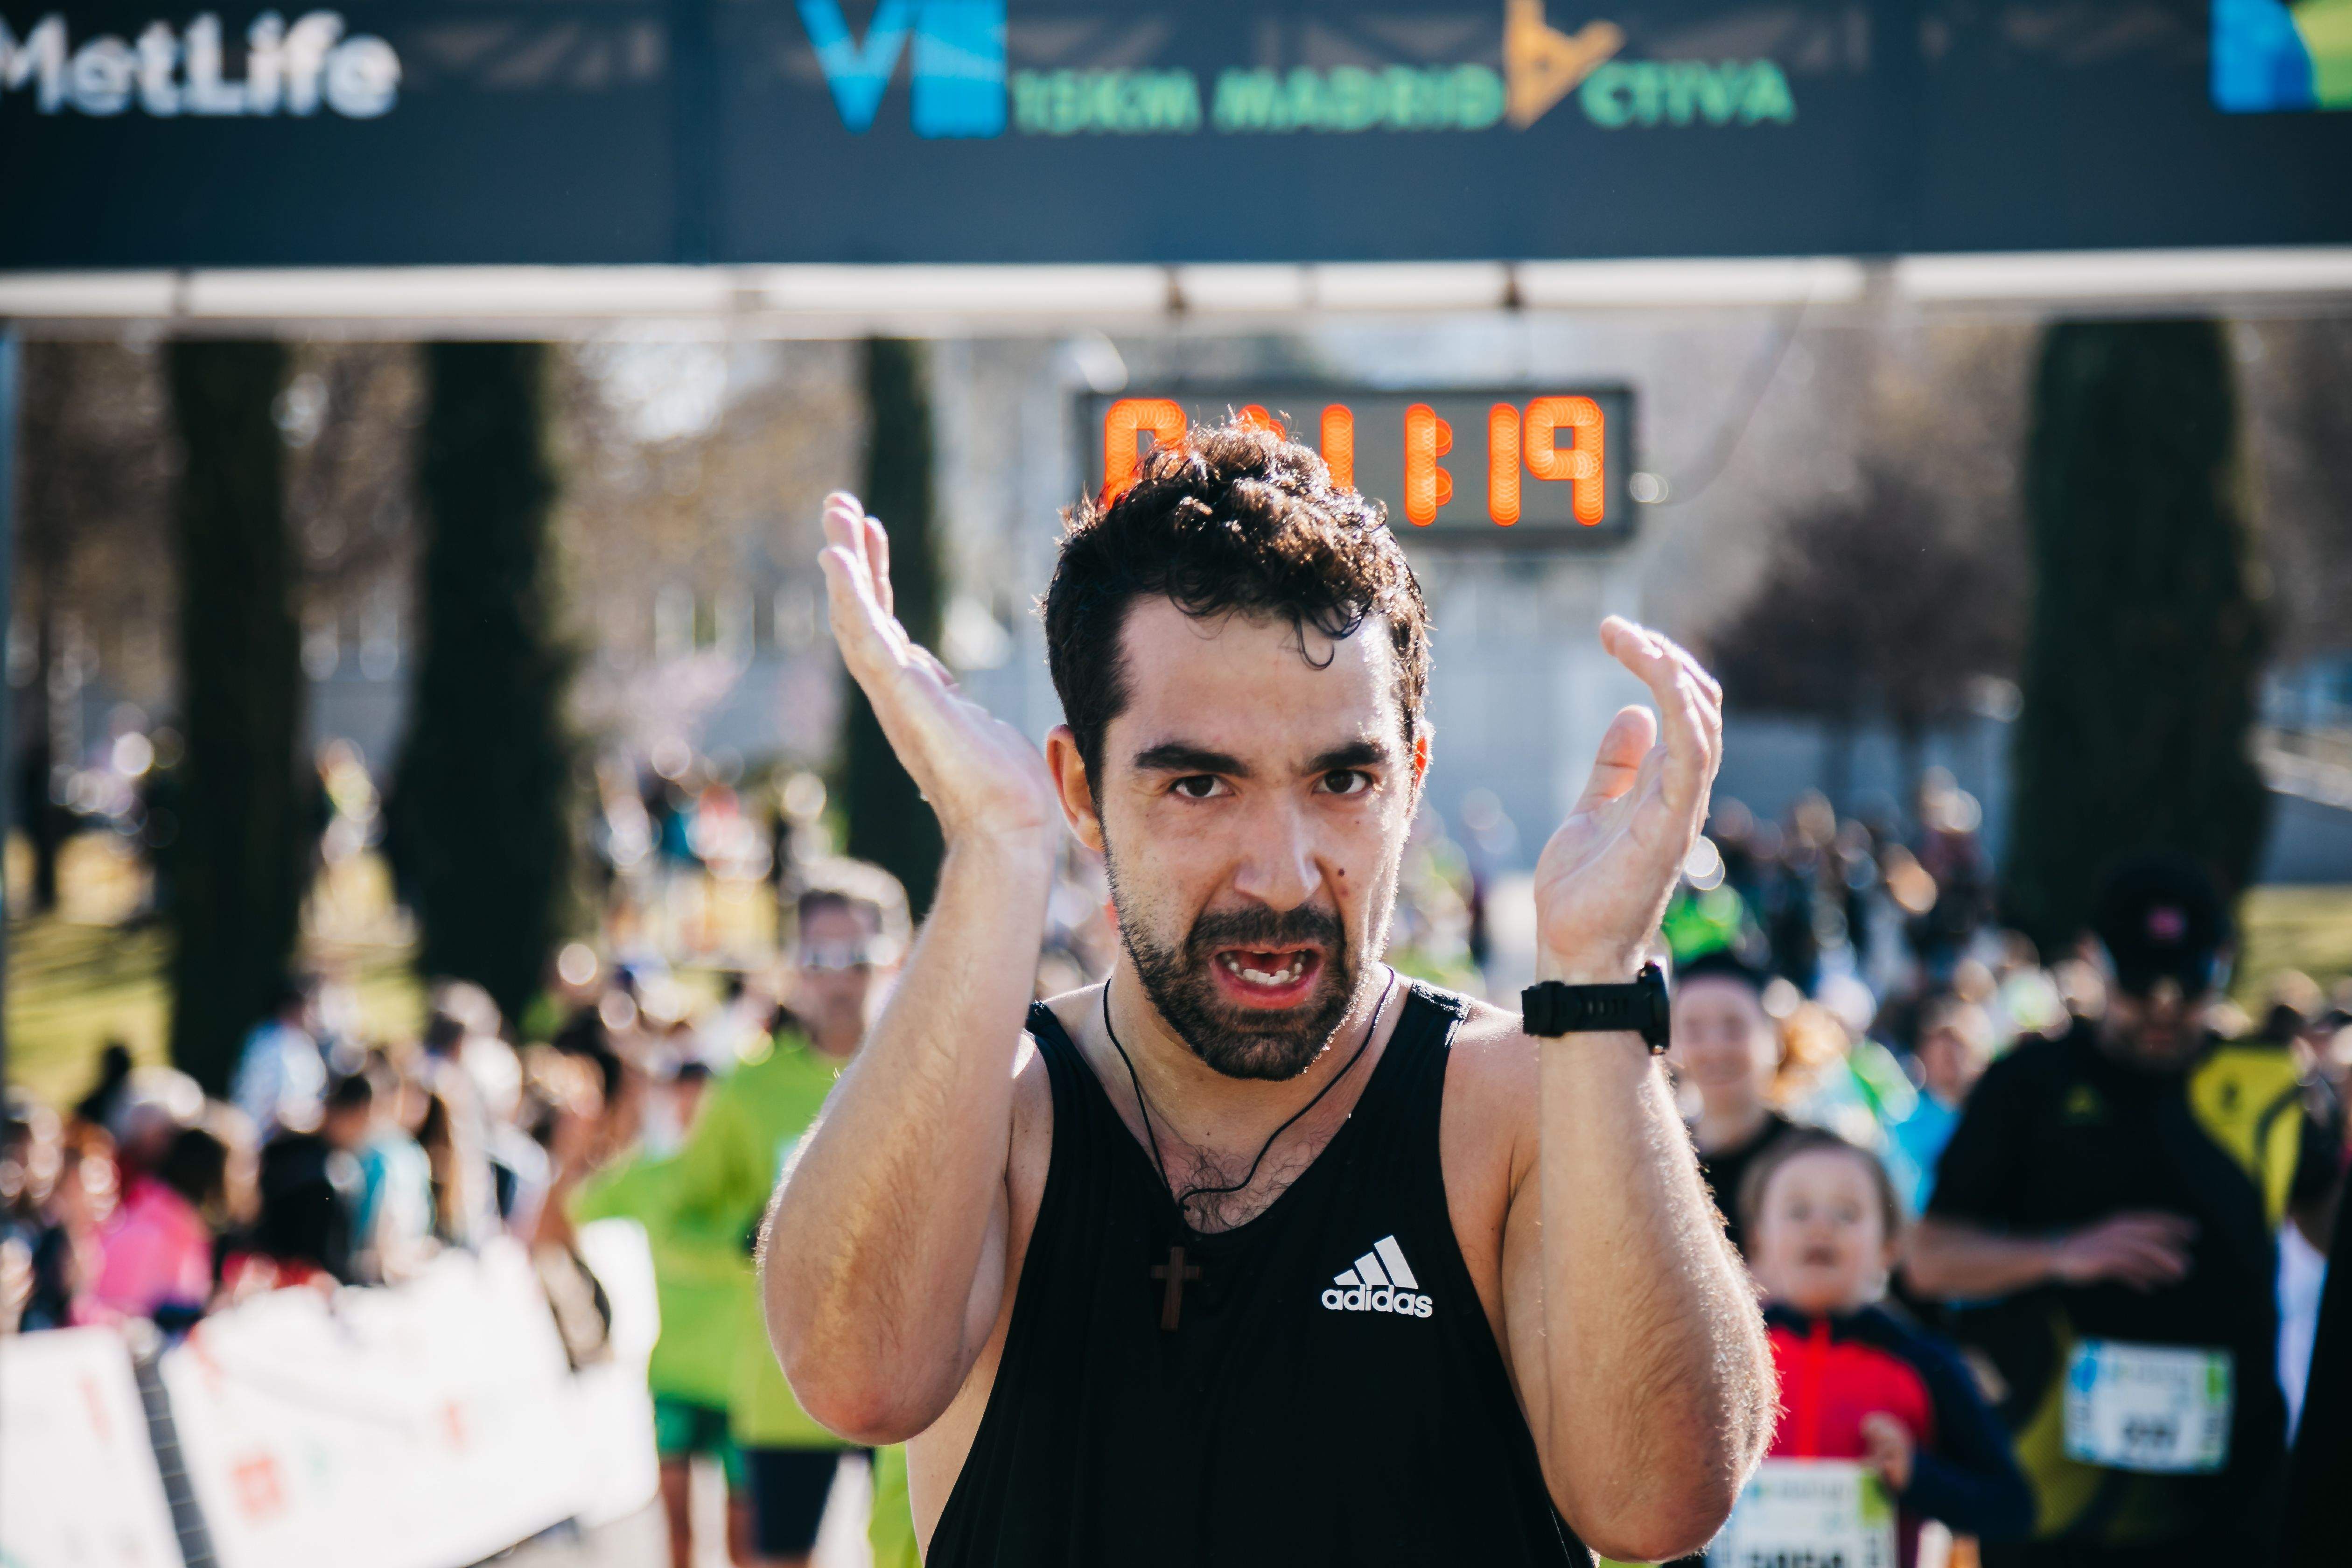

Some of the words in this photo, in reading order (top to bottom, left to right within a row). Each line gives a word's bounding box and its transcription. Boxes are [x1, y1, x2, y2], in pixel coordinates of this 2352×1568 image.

[0, 11, 402, 119] MetLife
[1212, 64, 1505, 133] MADRID
[1322, 1283, 1433, 1318] adidas
